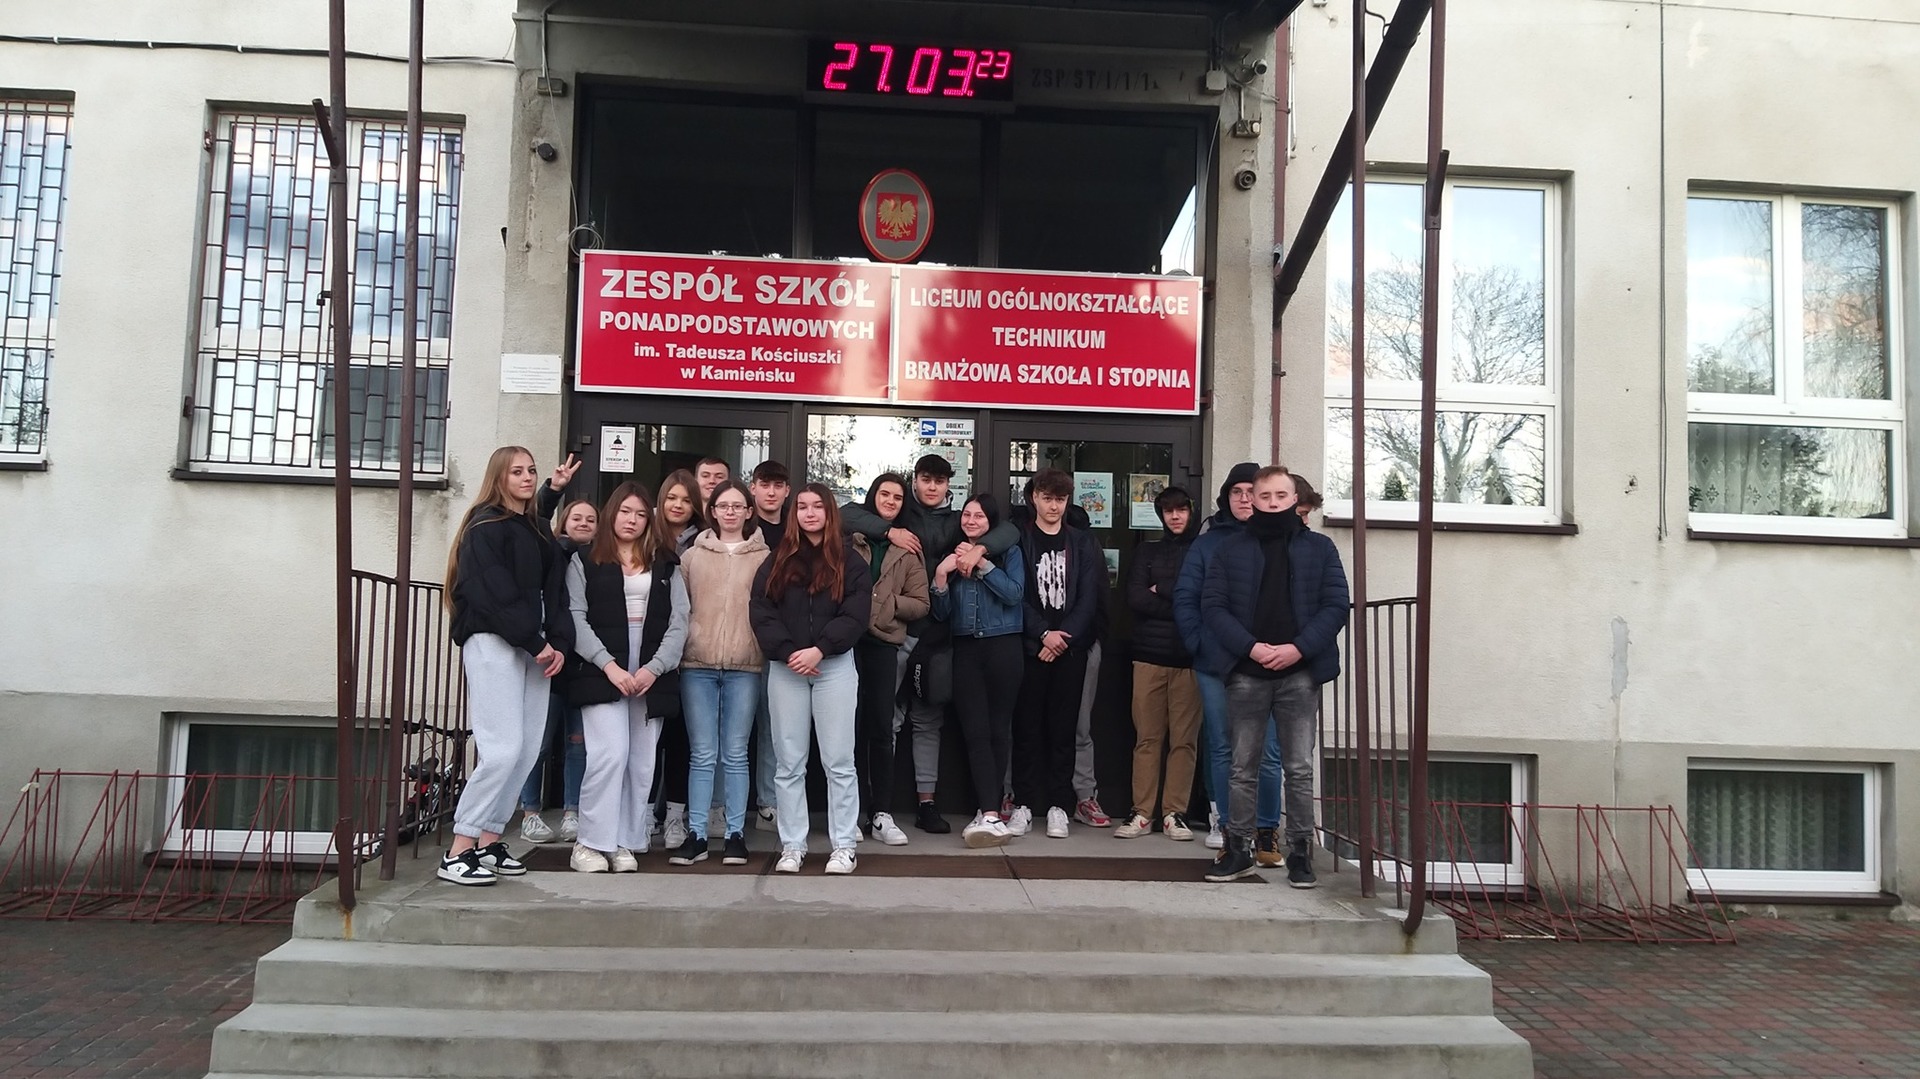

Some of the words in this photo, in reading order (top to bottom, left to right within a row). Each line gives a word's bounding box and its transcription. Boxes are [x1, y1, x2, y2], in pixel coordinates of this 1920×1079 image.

[975, 50, 1012, 79] 23
[600, 266, 744, 303] ZESPÓŁ
[755, 272, 876, 307] SZKÓŁ
[910, 288, 981, 309] LICEUM
[988, 287, 1189, 319] OGÓLNOKSZTAŁCĄCE
[599, 311, 875, 339] PONADPODSTAWOWYCH
[992, 327, 1106, 349] TECHNIKUM
[634, 342, 660, 358] im.
[666, 344, 745, 361] Tadeusza
[752, 346, 841, 364] Kościuszki
[681, 367, 695, 379] w
[701, 365, 796, 383] Kamieńsku
[905, 358, 1012, 383] BRANŻOWA
[1017, 364, 1091, 385] SZKOŁA
[1098, 367, 1103, 385] I
[1108, 367, 1190, 388] STOPNIA
[913, 664, 922, 697] adidas
